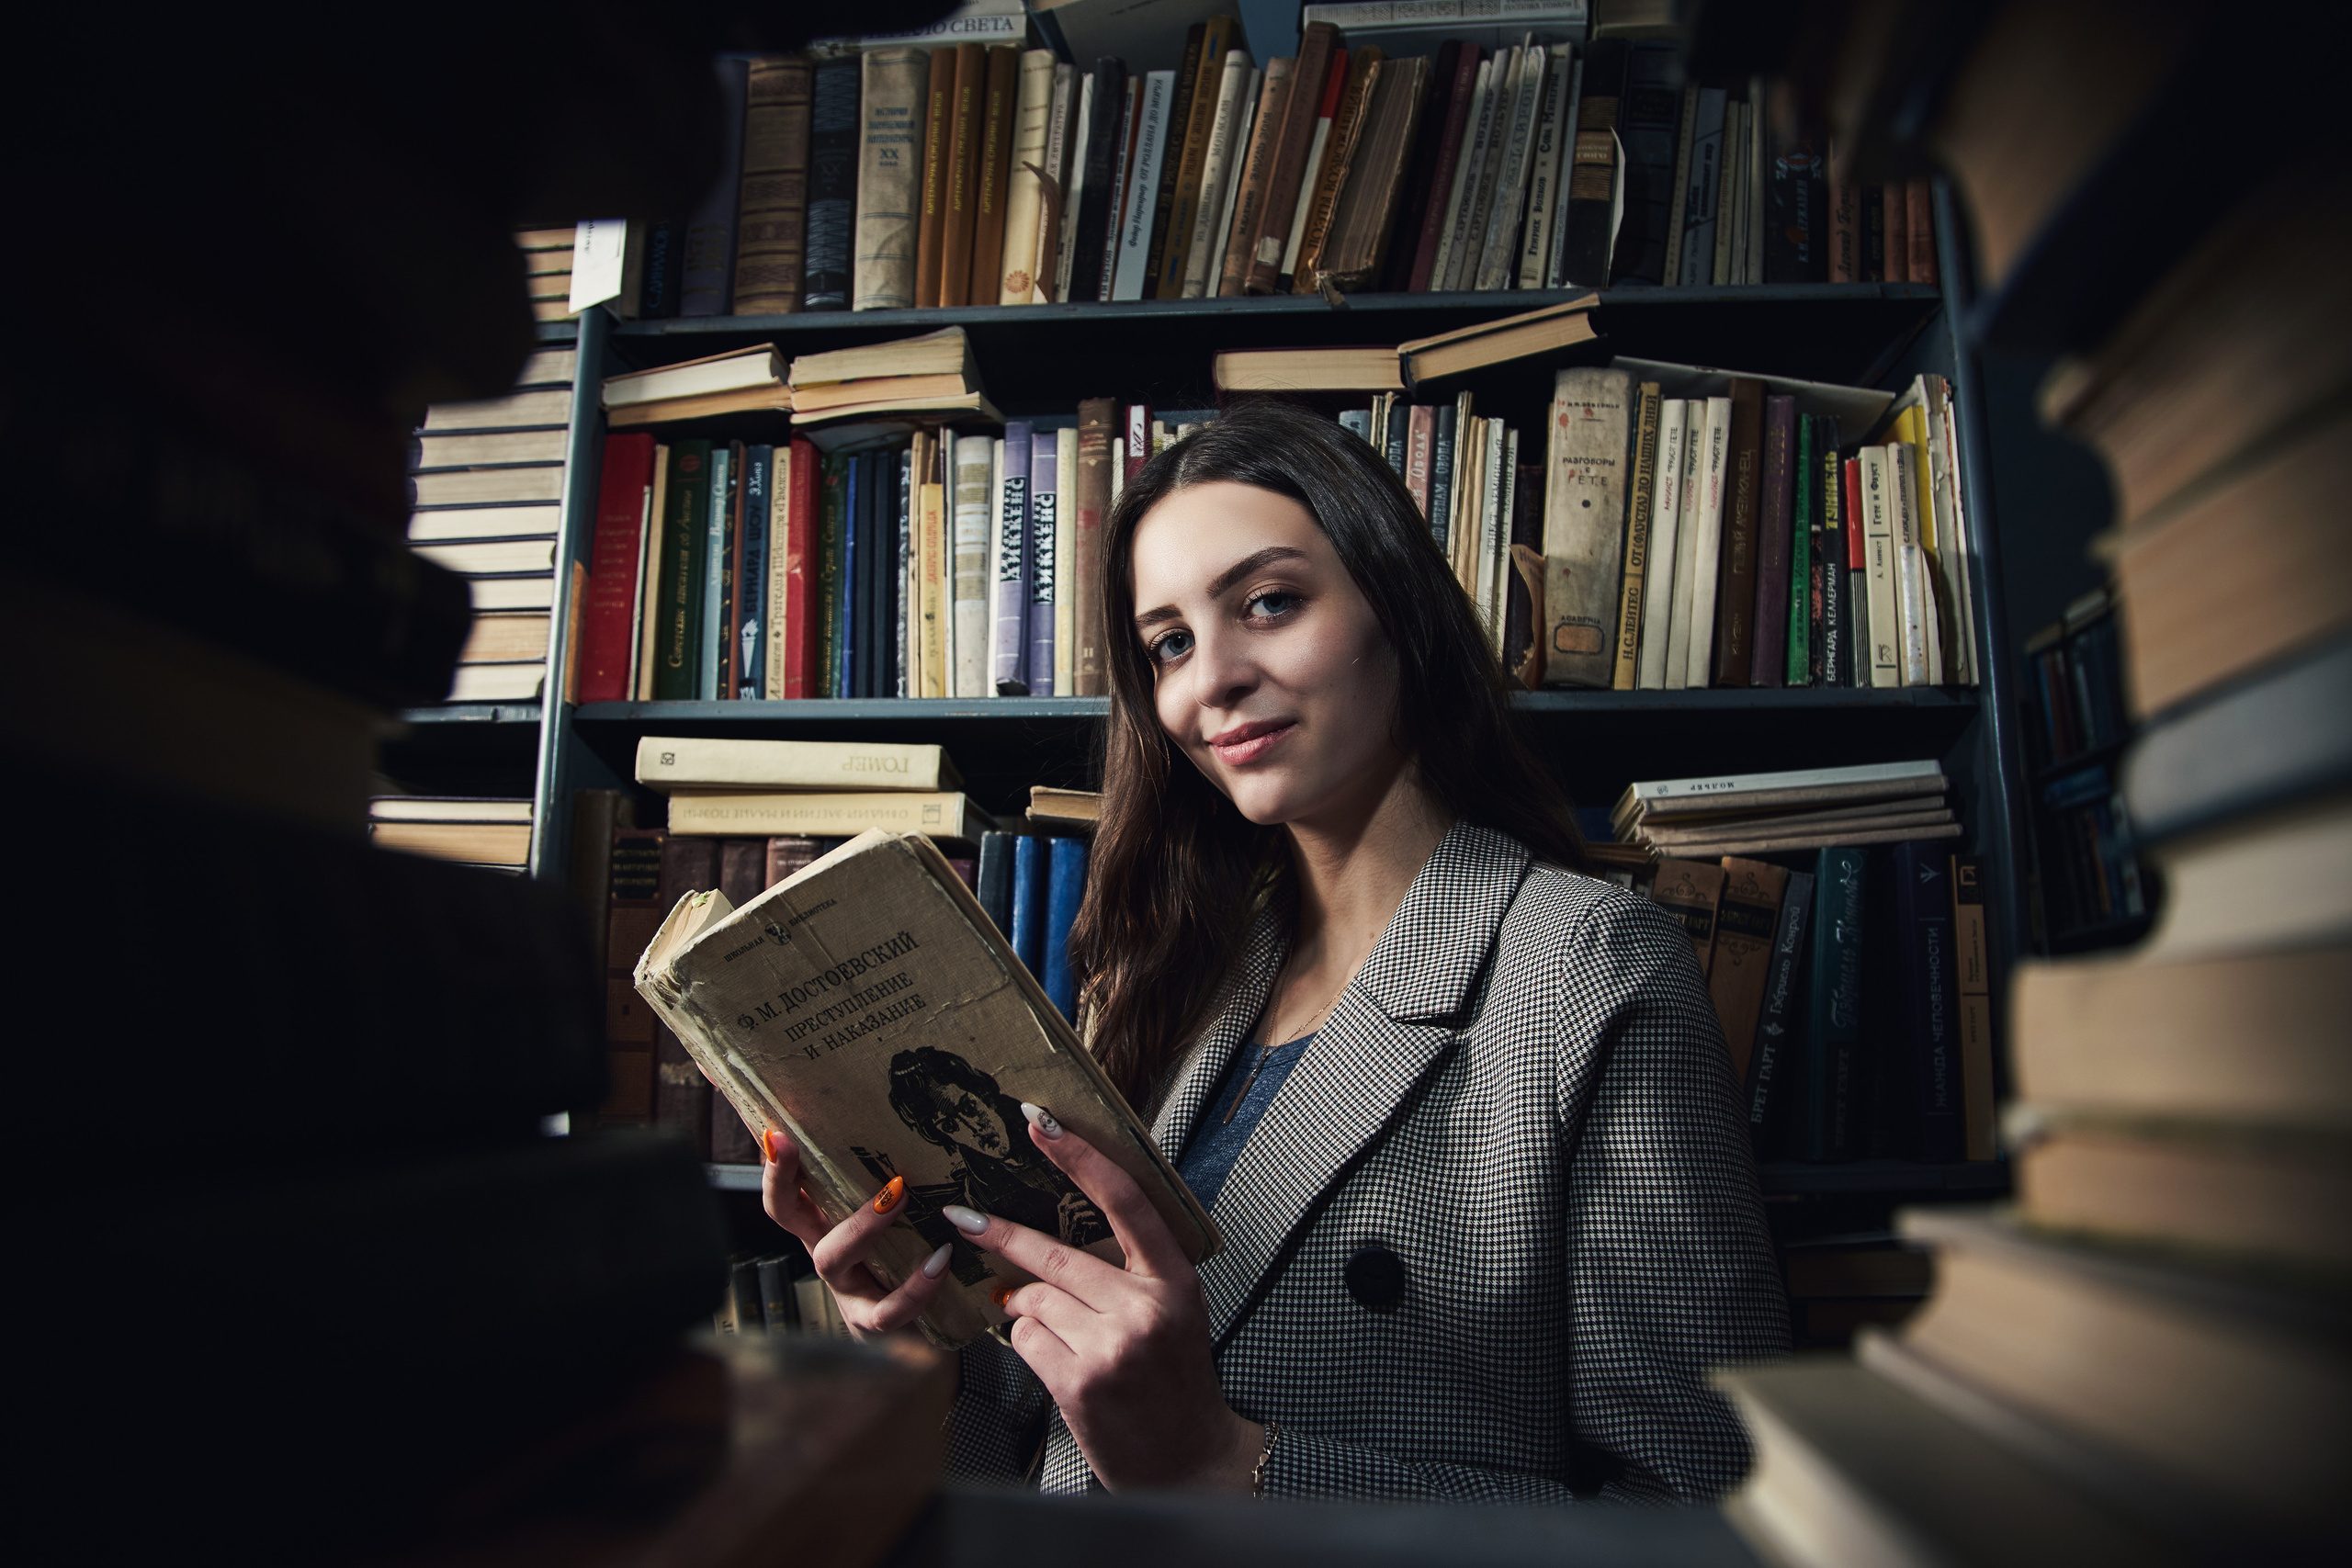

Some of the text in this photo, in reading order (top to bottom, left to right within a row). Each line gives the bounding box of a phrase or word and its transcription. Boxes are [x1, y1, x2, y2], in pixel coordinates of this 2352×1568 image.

[950, 17, 1013, 32] СВЕТА
[1148, 109, 1159, 124] ДО
[1149, 79, 1163, 108] МОРУА
[1212, 99, 1230, 157] МОПАССАН
[1476, 89, 1494, 150] ВОЛЬТЕР
[1491, 87, 1509, 149] ВОЛЬТЕР
[1510, 83, 1535, 160] БАЙРОН
[879, 148, 899, 159] XX
[927, 91, 944, 214] ЛИТЕРАТУРА СРЕДНИХ ВЕКОВ
[954, 87, 970, 210] ЛИТЕРАТУРА СРЕДНИХ ВЕКОВ
[983, 90, 1001, 213] ЛИТЕРАТУРА СРЕДНИХ ВЕКОВ
[1141, 125, 1157, 165] РОЛЛАНА
[1250, 112, 1272, 181] ЭМИЛЬ ЗОЛЯ
[1307, 85, 1363, 249] ПОЭТЫ ВОЗРОЖДЕНИЯ
[1704, 143, 1713, 160] мир
[1139, 167, 1148, 181] ОТ
[1128, 225, 1141, 247] Федор
[1796, 179, 1809, 263] К.Н.ЕРЖАВИН
[1836, 230, 1851, 277] Леонид
[1643, 394, 1657, 428] ДНЕЙ
[1668, 425, 1679, 444] ГЕТЕ
[1712, 425, 1723, 444] ГЕТЕ
[1638, 430, 1655, 475] НАШИХ
[1689, 428, 1700, 446] ГЕТЕ
[709, 463, 726, 536] Вальтер Скотт
[1487, 437, 1503, 554] ЭРНЕСТ ХЕМИНГУЭЙ
[1568, 475, 1608, 486] ГЕТЕ
[1637, 477, 1650, 493] ДО
[1734, 447, 1756, 527] АМЕРИКАНЕЦ
[1821, 450, 1840, 530] ТУННЕЛЬ
[1869, 462, 1880, 491] Фауст
[747, 503, 762, 541] ШОУ
[821, 504, 835, 543] Советов
[1432, 482, 1447, 525] СЛЕДАМ
[1497, 446, 1514, 562] ЭРНЕСТ ХЕМИНГУЭЙ
[1871, 504, 1882, 525] Гете
[772, 514, 787, 569] Шекспира
[1007, 478, 1024, 580] ДИККЕНС
[1039, 494, 1056, 602] ДИККЕНС
[820, 547, 837, 582] Стране
[1630, 549, 1643, 567] ОТ
[1874, 540, 1883, 567] Аникст
[668, 489, 693, 668] Советские писатели об Англии
[743, 548, 760, 613] БЕРНАРД
[770, 571, 786, 627] Трагедия
[1561, 615, 1600, 624] ACADEMIA
[1824, 562, 1840, 682] БЕРНГАРД КЕЛЛЕРМАН
[841, 752, 910, 775] ГОМЕР
[1689, 780, 1735, 792] МОЛЬЕР
[683, 807, 729, 819] ПОЭМЫ
[734, 807, 778, 818] МАЛЫЕ
[724, 897, 837, 963] ШКОЛЬНАЯ БИБЛИОТЕКА
[1689, 915, 1710, 931] ГАРТ
[737, 930, 920, 1032] Ф. М. ДОСТОЕВСКИЙ
[1828, 946, 1859, 1030] Гэбриель
[784, 972, 914, 1043] ПРЕСТУПЛЕНИЕ
[803, 993, 927, 1060] И НАКАЗАНИЕ
[1751, 905, 1804, 1124] БРЕТ ГАРТ Гэбриель Конрой
[1927, 926, 1945, 1107] ЖАЖДА ЧЕЛОВЕЧНОСТИ
[1835, 1047, 1849, 1095] ГАРТ
[1833, 1100, 1848, 1147] БРЕТ
